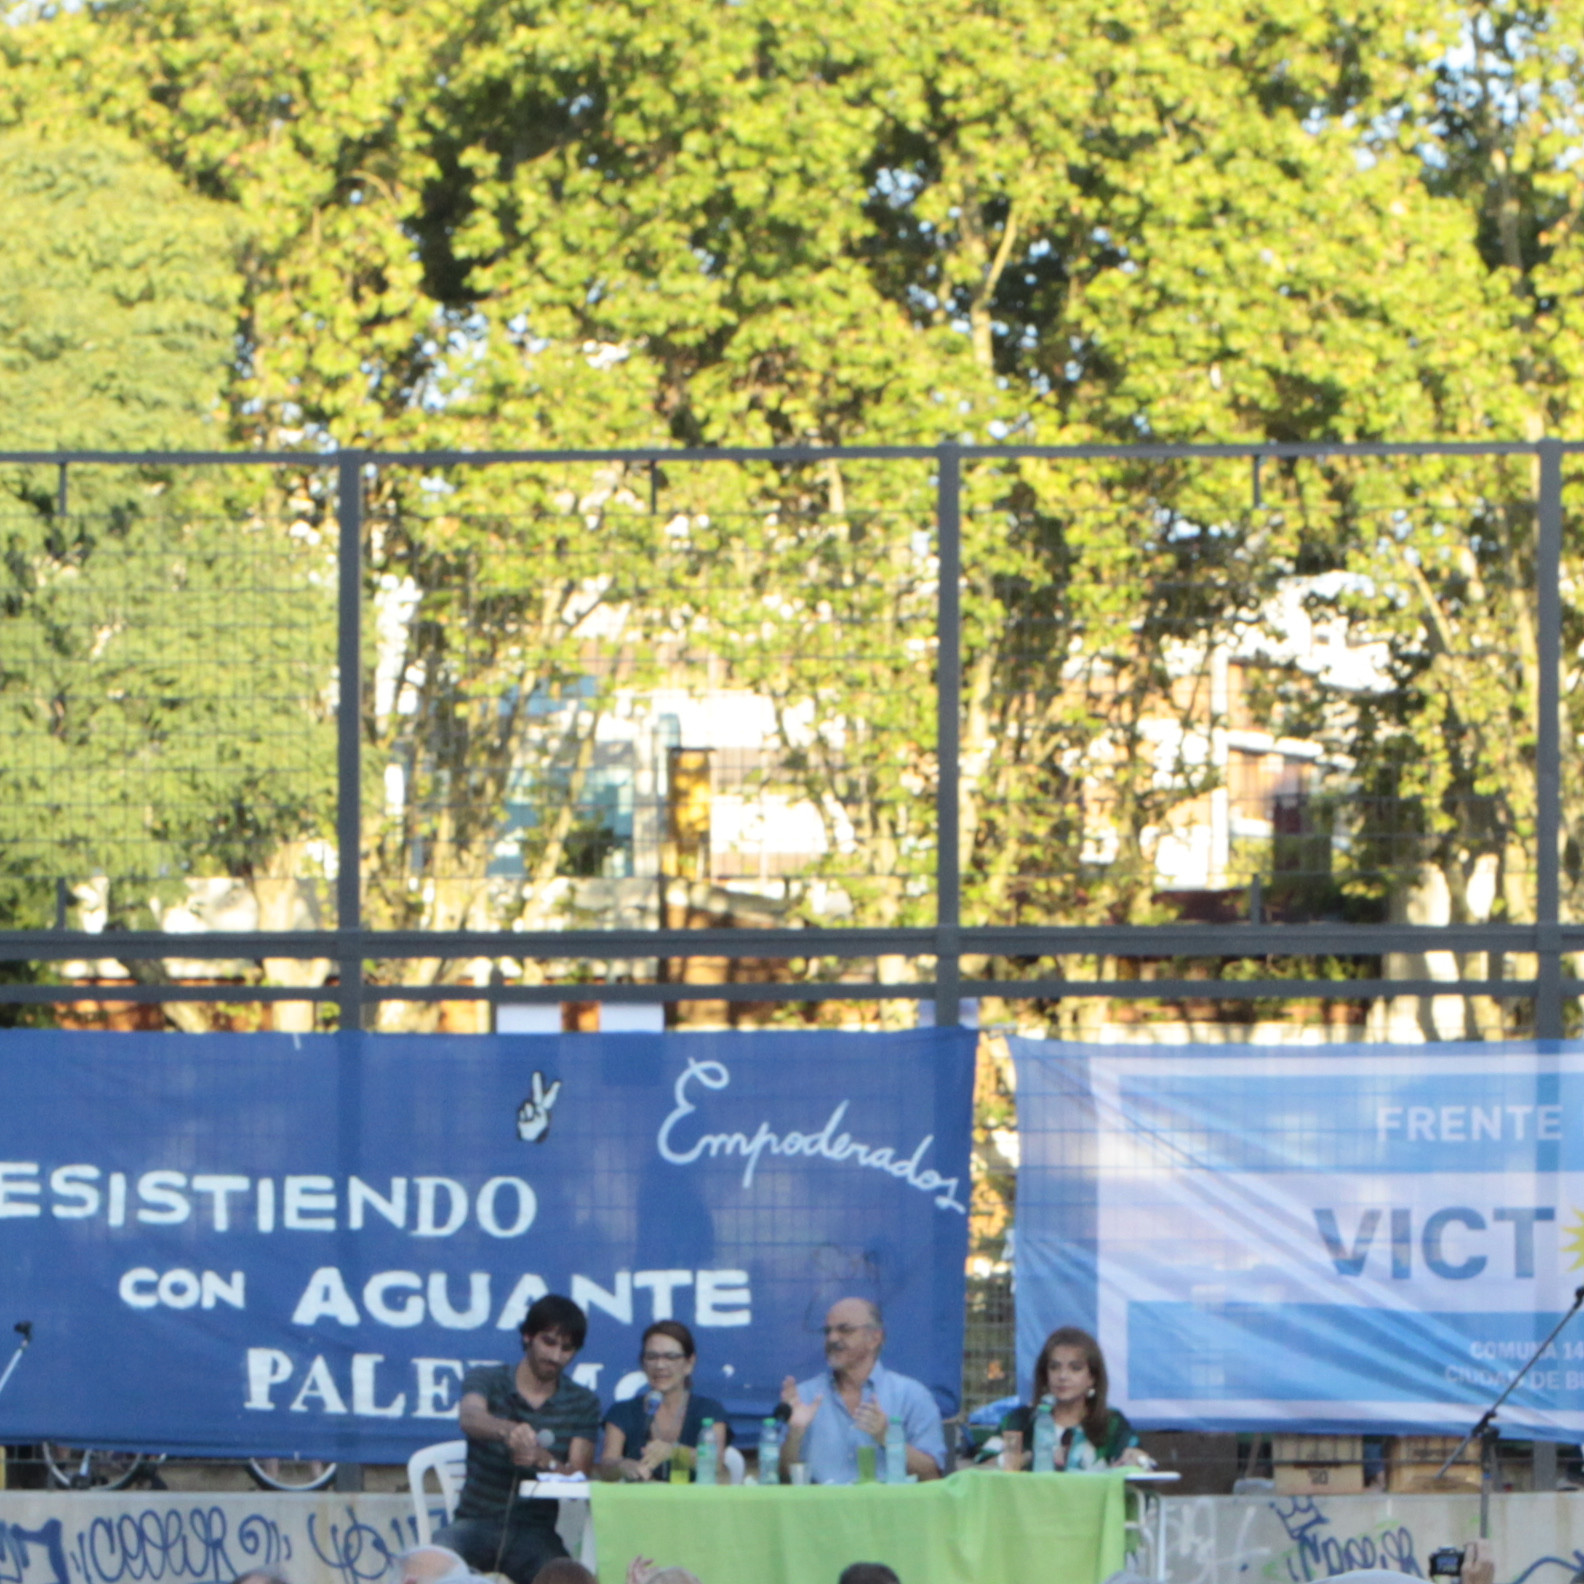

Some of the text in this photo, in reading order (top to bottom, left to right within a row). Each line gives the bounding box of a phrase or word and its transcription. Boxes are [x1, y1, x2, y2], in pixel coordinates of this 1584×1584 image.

[658, 1058, 965, 1214] Empoderados
[1377, 1103, 1563, 1142] FRENTE
[119, 1267, 751, 1330] CON AGUANTE
[1530, 1370, 1562, 1390] DE
